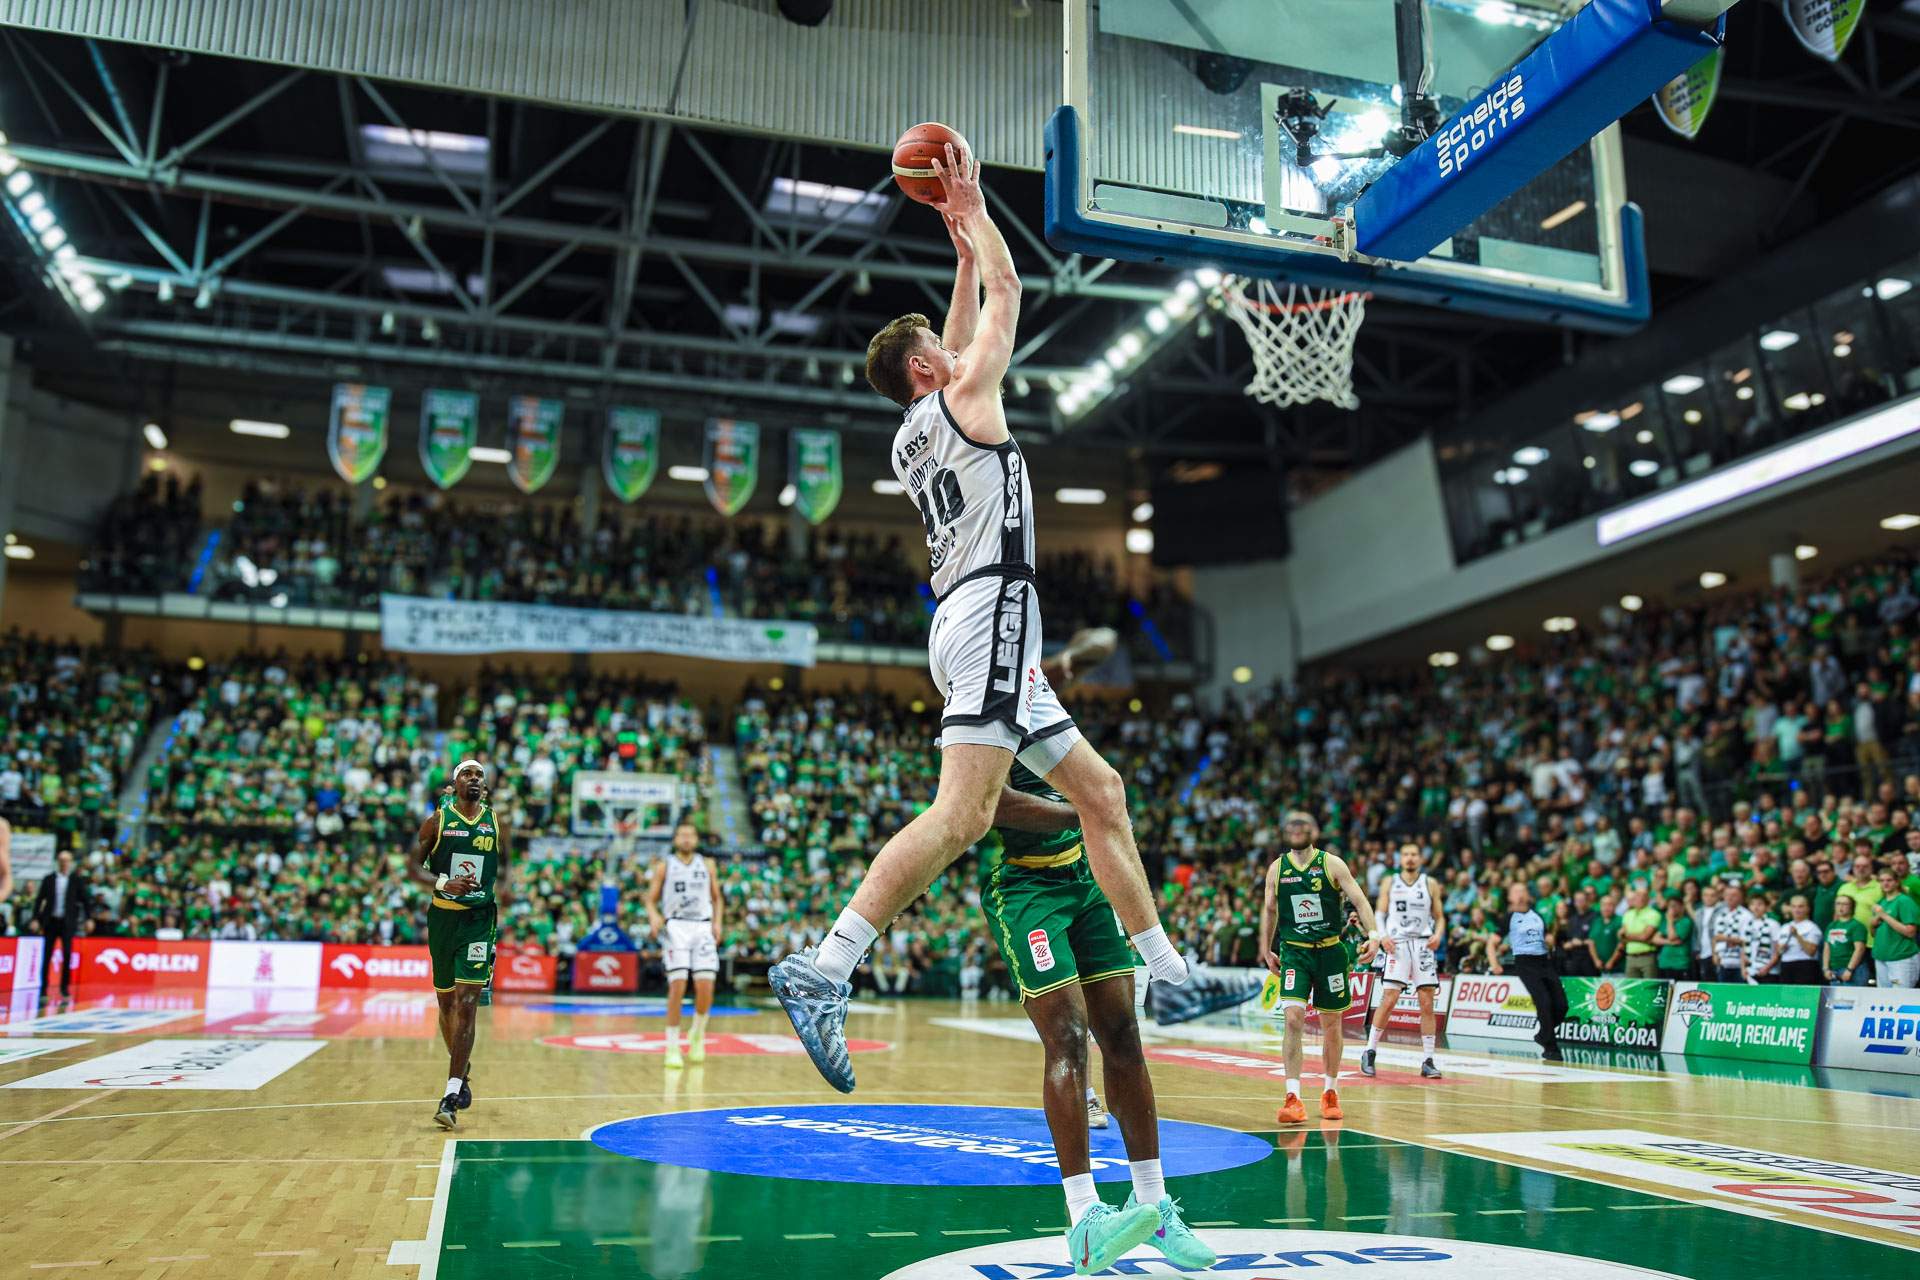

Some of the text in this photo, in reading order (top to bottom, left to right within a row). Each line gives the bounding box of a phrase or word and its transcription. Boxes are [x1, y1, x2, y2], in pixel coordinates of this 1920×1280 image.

[1437, 75, 1523, 157] Schelde
[1439, 96, 1526, 178] Sports
[472, 835, 494, 852] 40
[1311, 877, 1322, 891] 3
[131, 953, 199, 971] ORLEN
[364, 958, 429, 977] ORLEN
[1456, 981, 1510, 1004] BRICO
[1726, 1001, 1737, 1015] Tu
[1734, 1002, 1756, 1018] jest
[1756, 1003, 1796, 1020] miejsce
[1796, 1007, 1810, 1019] na
[1489, 1014, 1538, 1029] POMORSKIE
[1859, 1017, 1920, 1042] ARP
[1613, 1021, 1658, 1047] GÓRA
[1700, 1021, 1808, 1053] TWOJĄ REKLAMĘ
